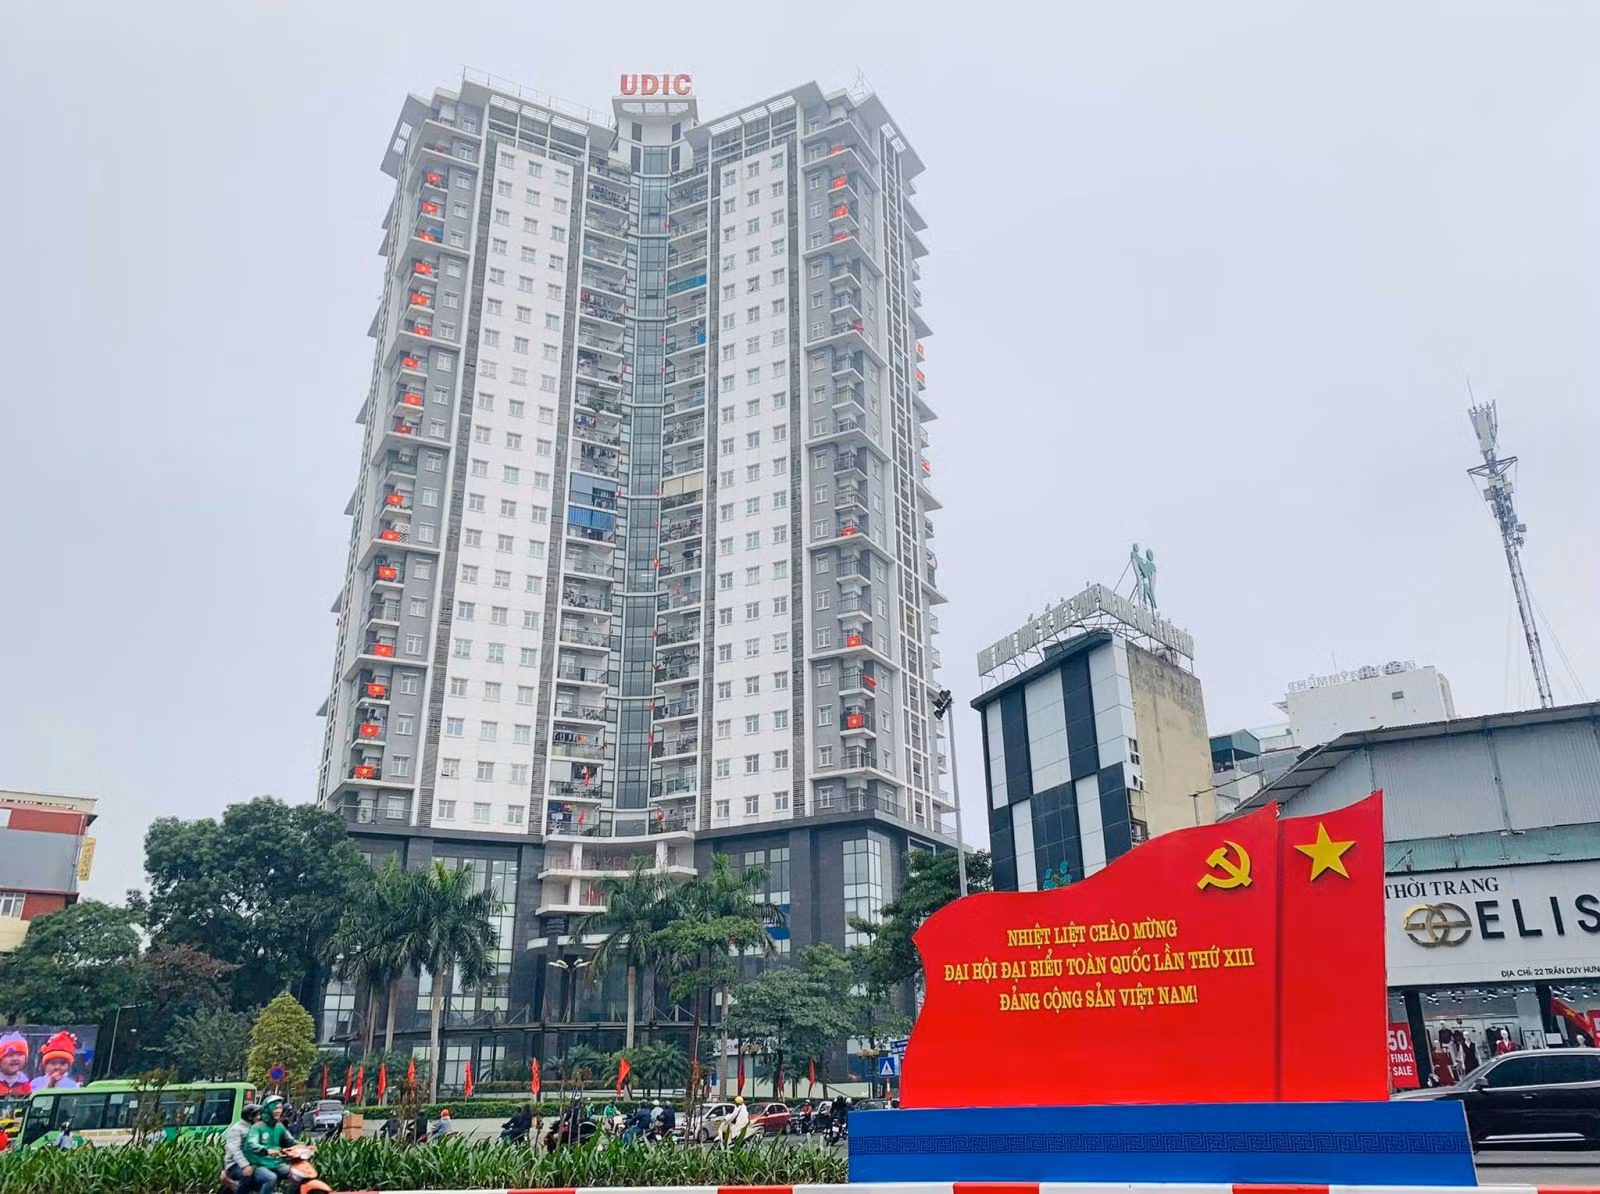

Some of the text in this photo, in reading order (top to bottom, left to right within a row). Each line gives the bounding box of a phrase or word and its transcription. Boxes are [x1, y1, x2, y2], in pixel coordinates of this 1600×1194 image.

[620, 74, 692, 96] UDIC
[1429, 876, 1499, 896] TRANG
[1475, 894, 1600, 940] ELIS
[1007, 916, 1178, 950] NHIỆT LIỆT CHÀO MỪNG
[944, 943, 1255, 985] ĐẠI HỘI ĐẠI BIỂU TOÀN QUỐC LẦN THỨ XIII
[1501, 970, 1515, 979] ĐỊA
[1534, 968, 1544, 976] 22
[1000, 981, 1198, 1014] ĐẢNG CỘNG SẢN VIỆT NAM!
[1390, 1053, 1414, 1063] FINAL
[1392, 1066, 1413, 1076] SALE
